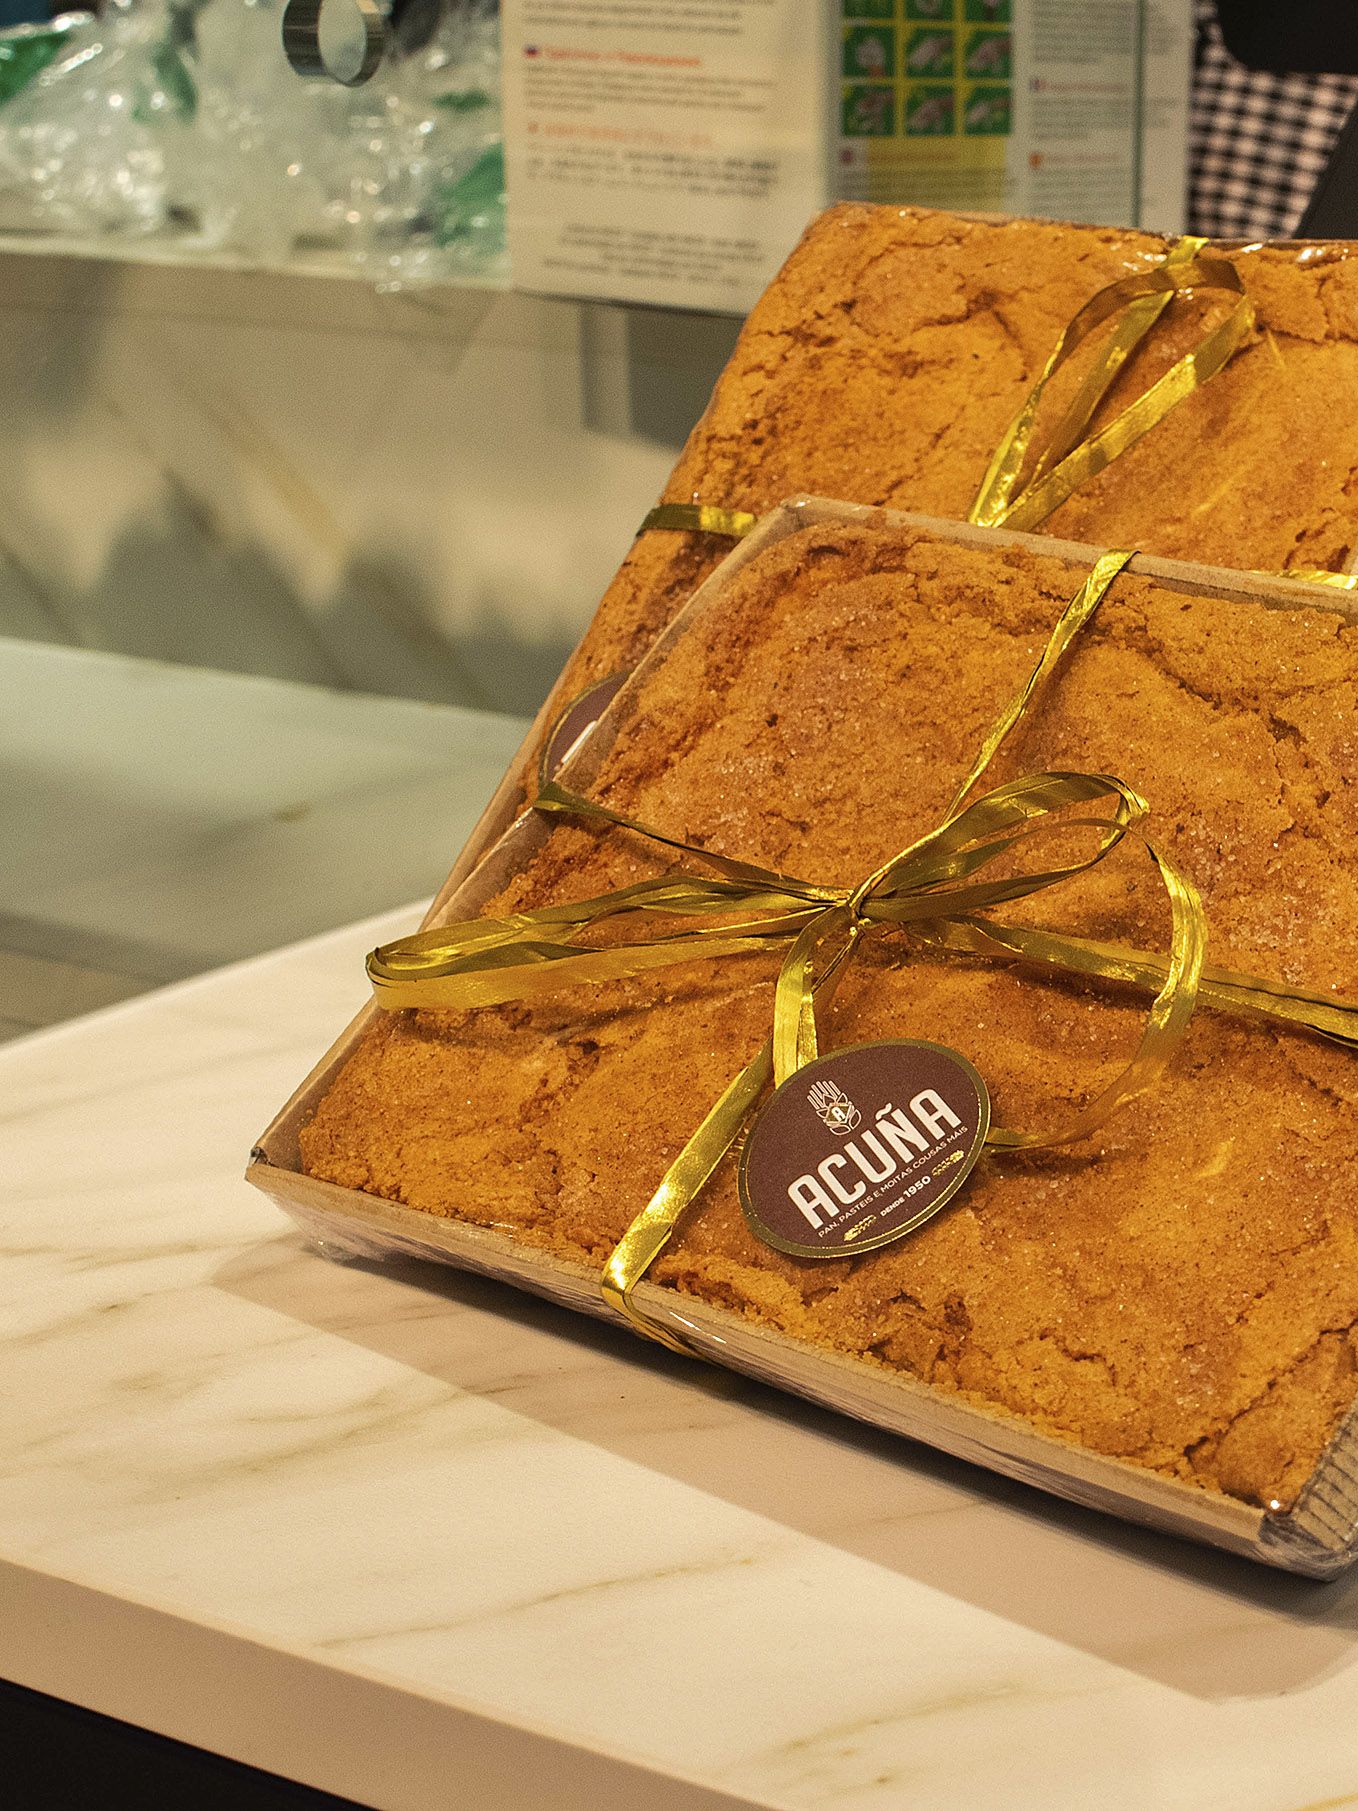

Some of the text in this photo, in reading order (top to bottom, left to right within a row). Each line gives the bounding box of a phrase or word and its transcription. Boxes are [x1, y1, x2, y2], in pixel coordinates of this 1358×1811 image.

[787, 1088, 962, 1230] ACUÑA
[818, 1221, 840, 1238] PAN,
[838, 1195, 874, 1223] PASTEIS
[880, 1167, 913, 1193] MOITAS
[912, 1141, 948, 1169] COUSAS
[946, 1125, 968, 1143] MAIS
[880, 1175, 931, 1217] DENDE 1950
